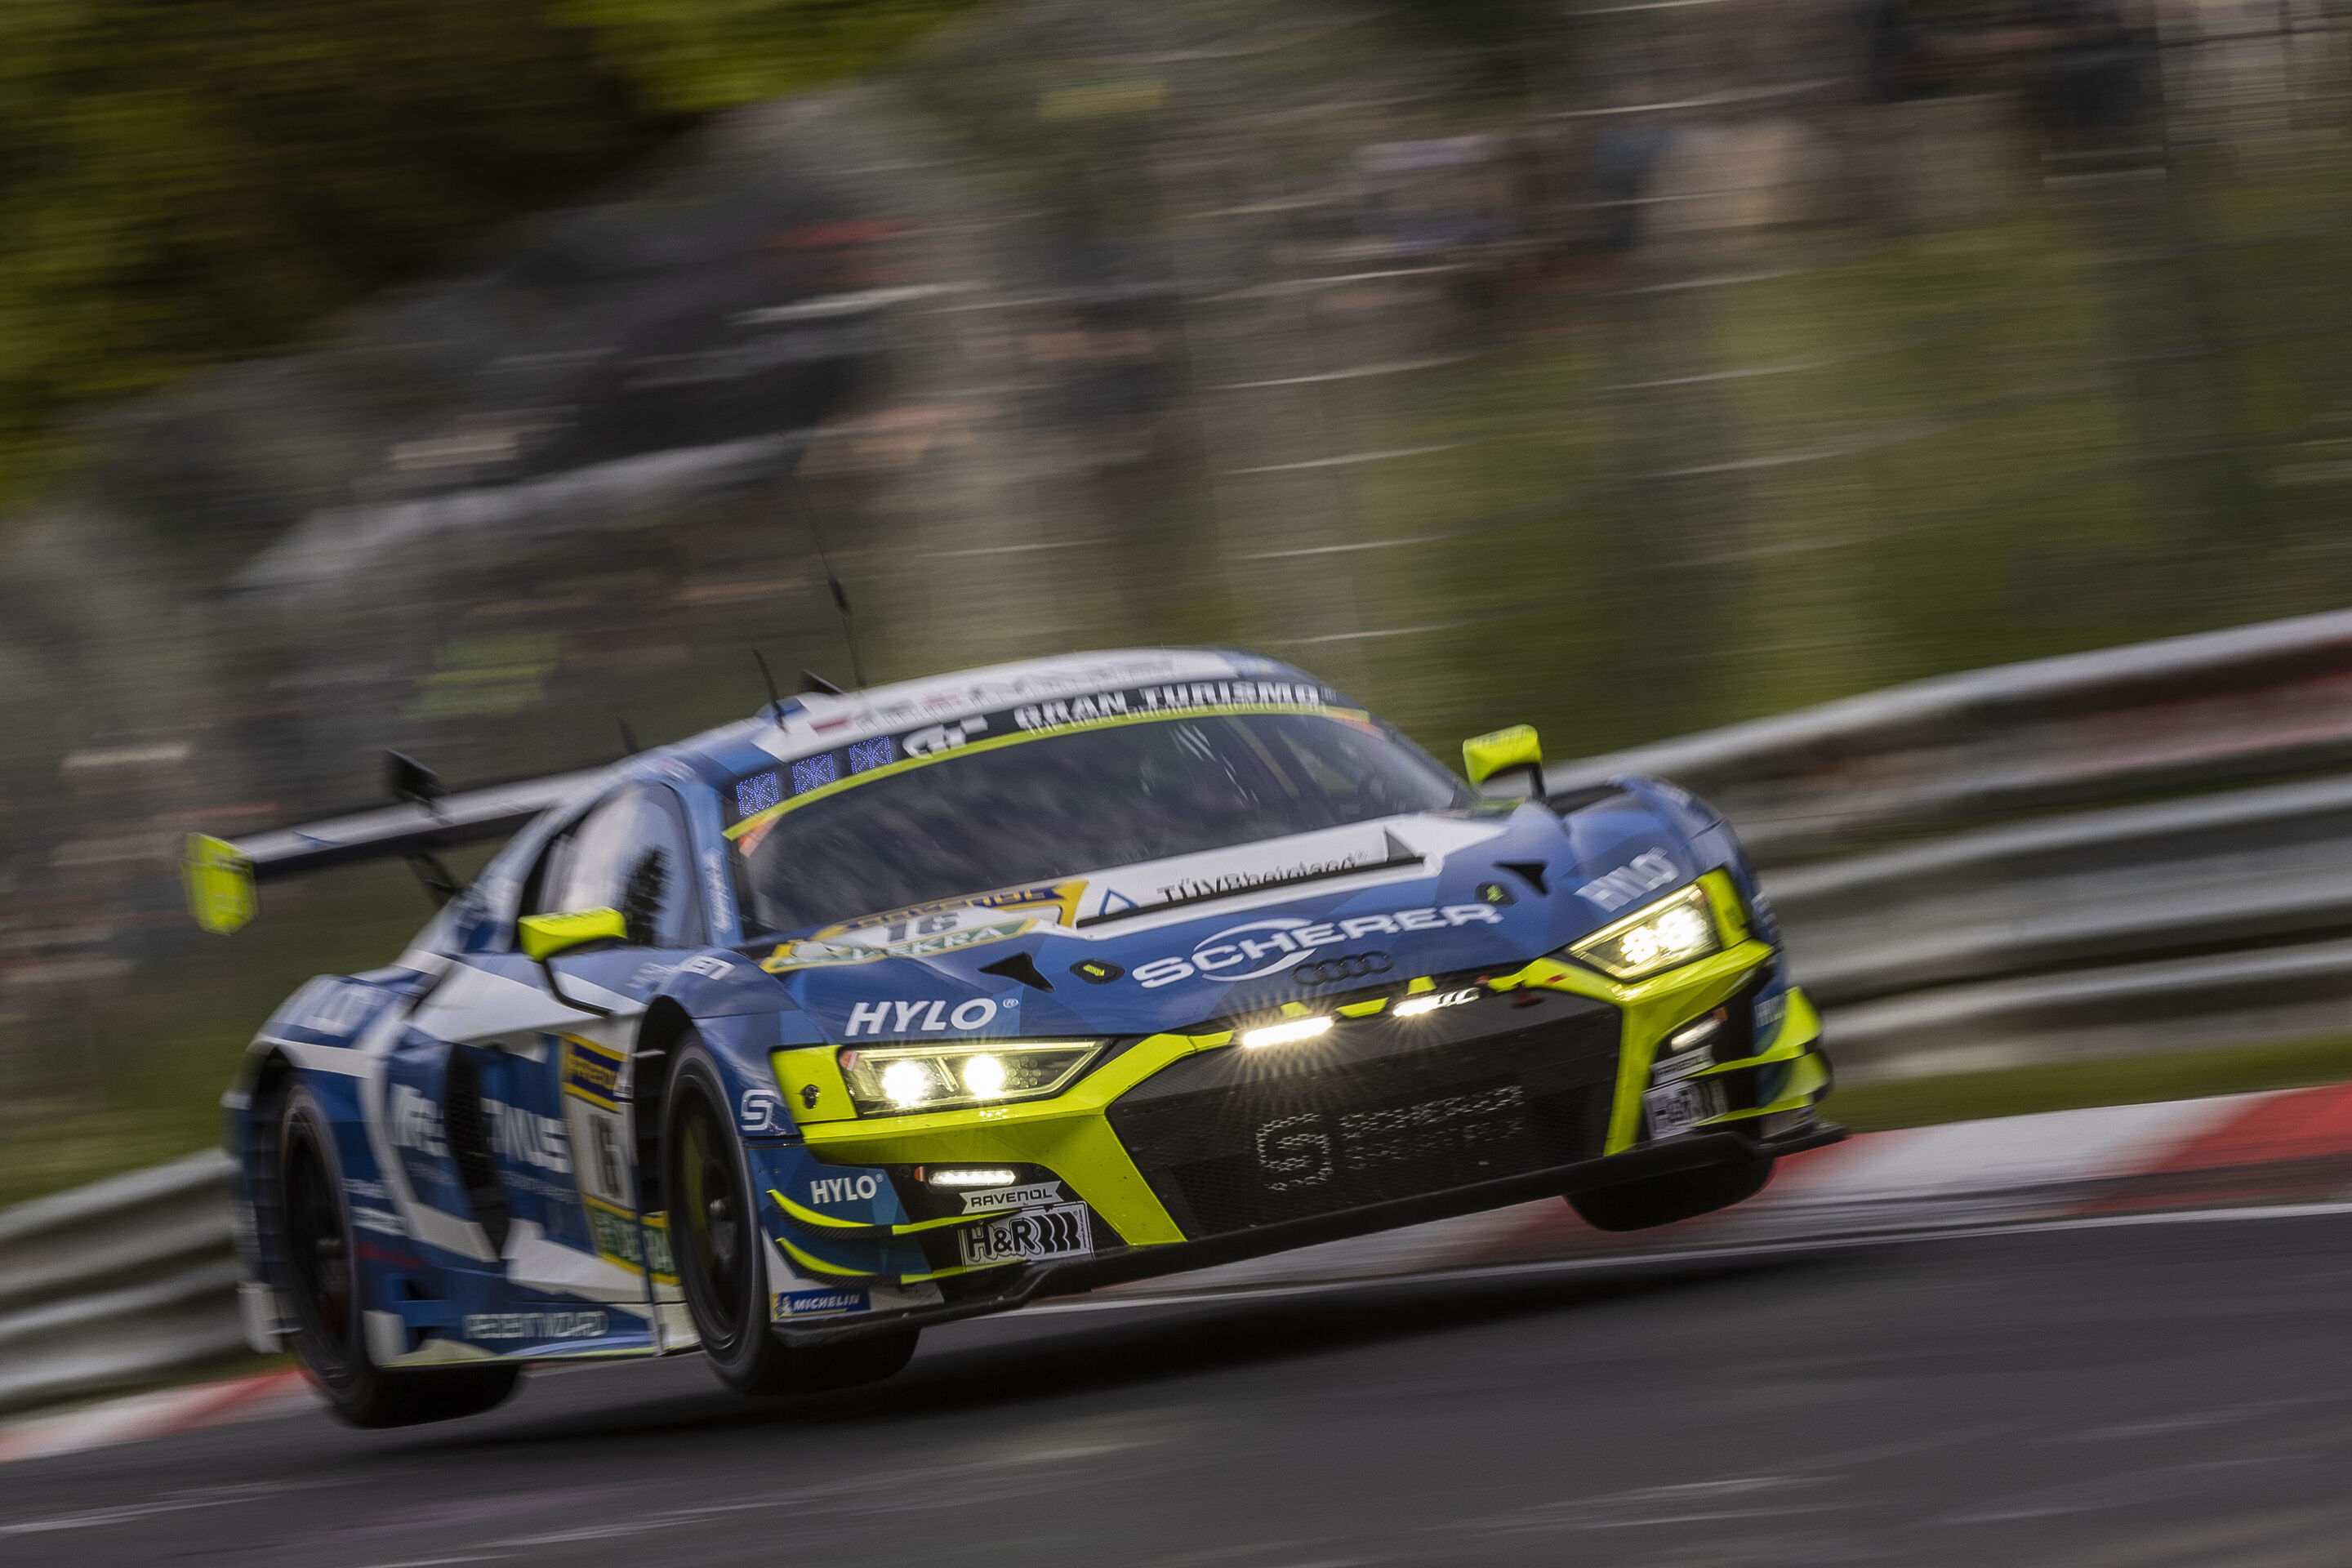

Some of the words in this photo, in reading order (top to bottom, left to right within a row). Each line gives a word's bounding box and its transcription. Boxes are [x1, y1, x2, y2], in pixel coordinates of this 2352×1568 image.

[1132, 903, 1505, 989] SCHERER
[970, 1187, 1053, 1208] RAVENOL
[965, 1219, 1038, 1260] H&R
[792, 1293, 861, 1312] MICHELIN
